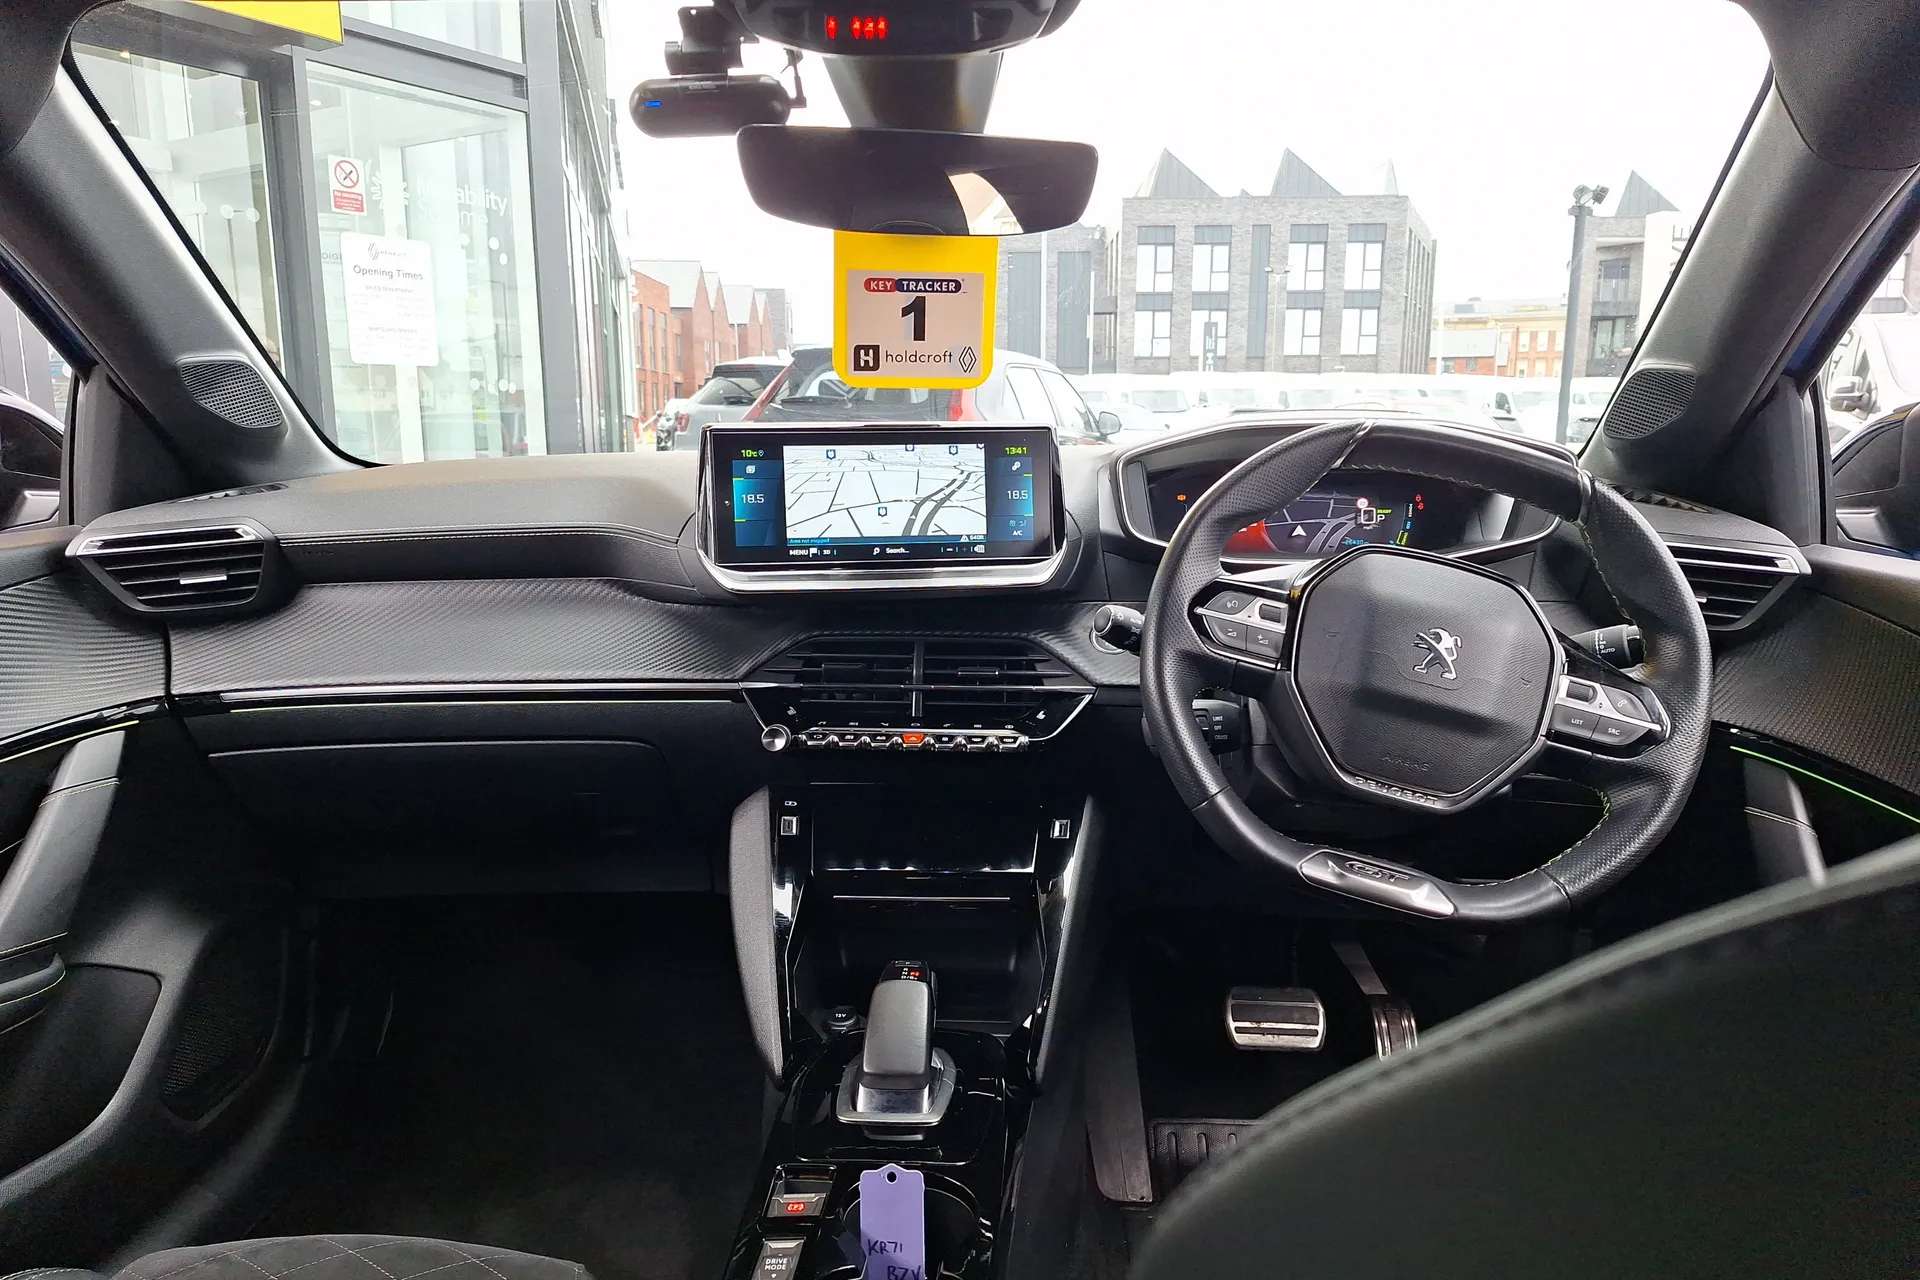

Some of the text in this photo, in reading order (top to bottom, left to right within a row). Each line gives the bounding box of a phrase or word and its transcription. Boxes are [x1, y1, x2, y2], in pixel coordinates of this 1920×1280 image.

[352, 264, 424, 281] Opening Times
[869, 280, 956, 292] KEY TRACKER
[901, 295, 926, 342] 1
[885, 350, 953, 364] holdcroft
[741, 493, 765, 504] 18.5
[1007, 489, 1029, 500] 18.5
[1354, 776, 1439, 806] PEUGEOT
[867, 1239, 903, 1256] KR71
[765, 1257, 788, 1265] DRIVE
